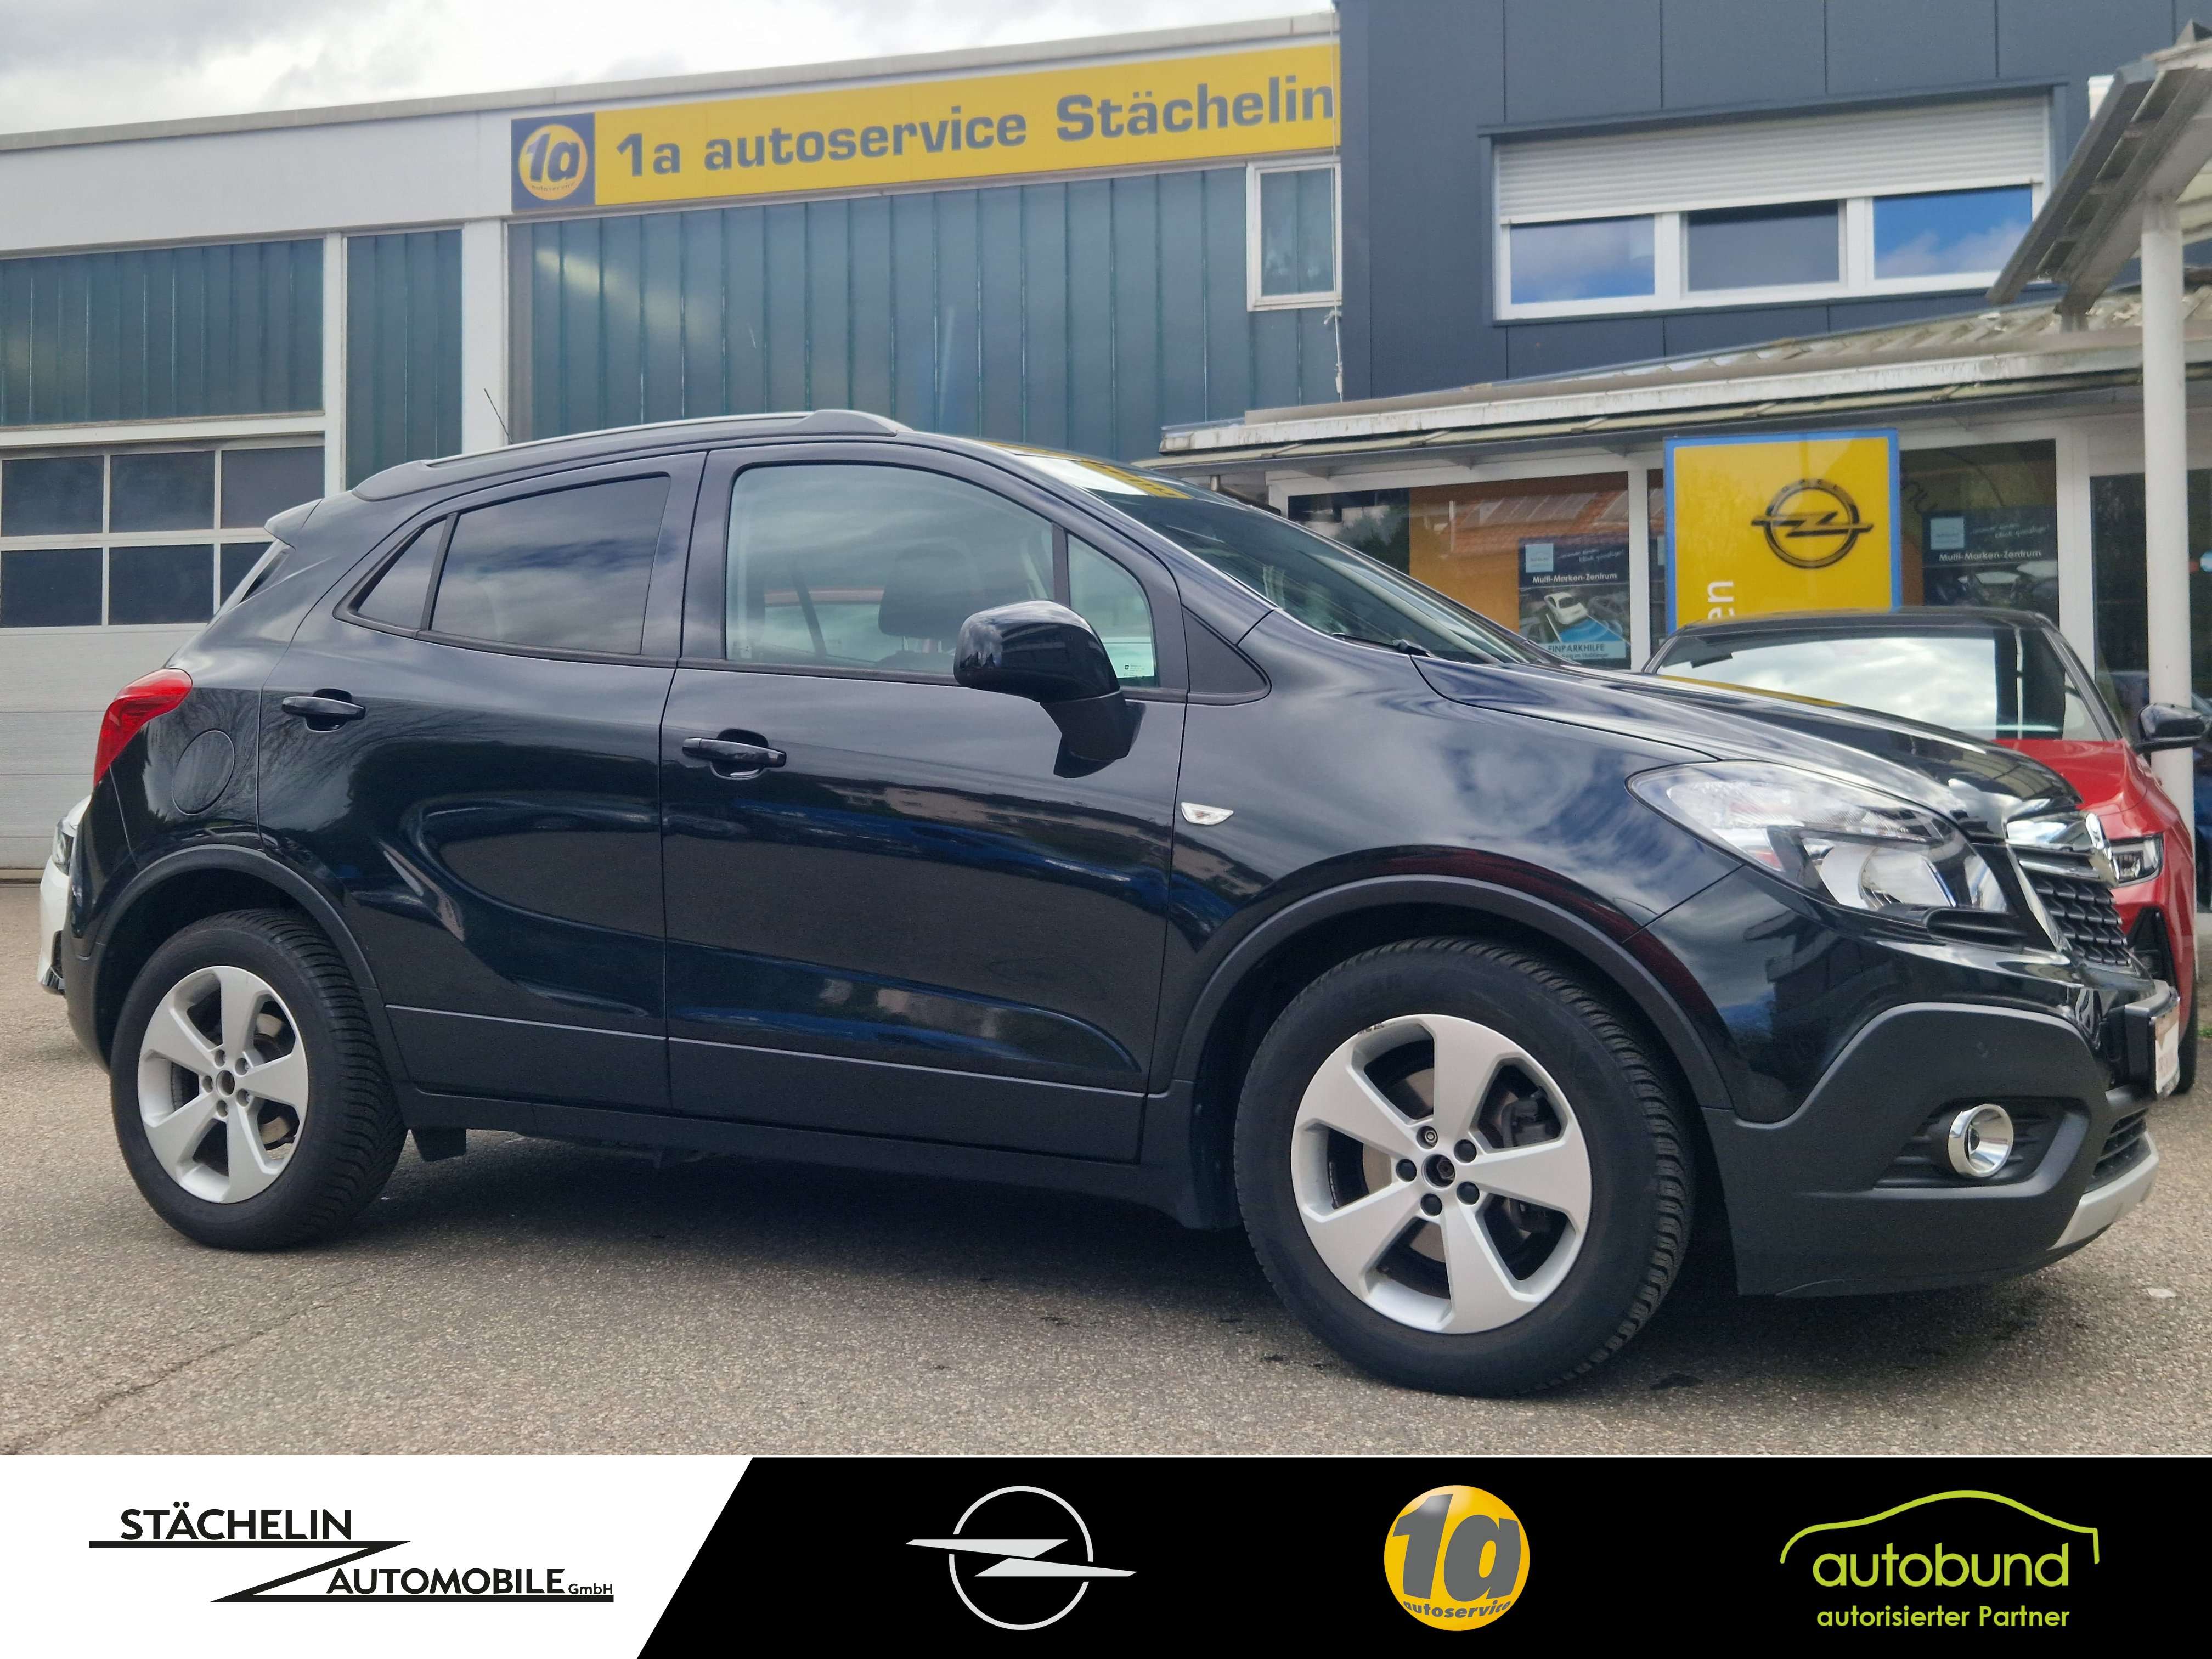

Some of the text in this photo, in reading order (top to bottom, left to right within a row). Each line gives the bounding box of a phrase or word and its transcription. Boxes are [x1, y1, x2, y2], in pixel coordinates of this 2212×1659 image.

[616, 75, 1334, 177] 1a autoservice Stächelin
[527, 133, 580, 182] 1a
[1939, 550, 2041, 562] Multi-Marken-Zentrum
[1532, 573, 1617, 584] Multi-Marken-Zentrum
